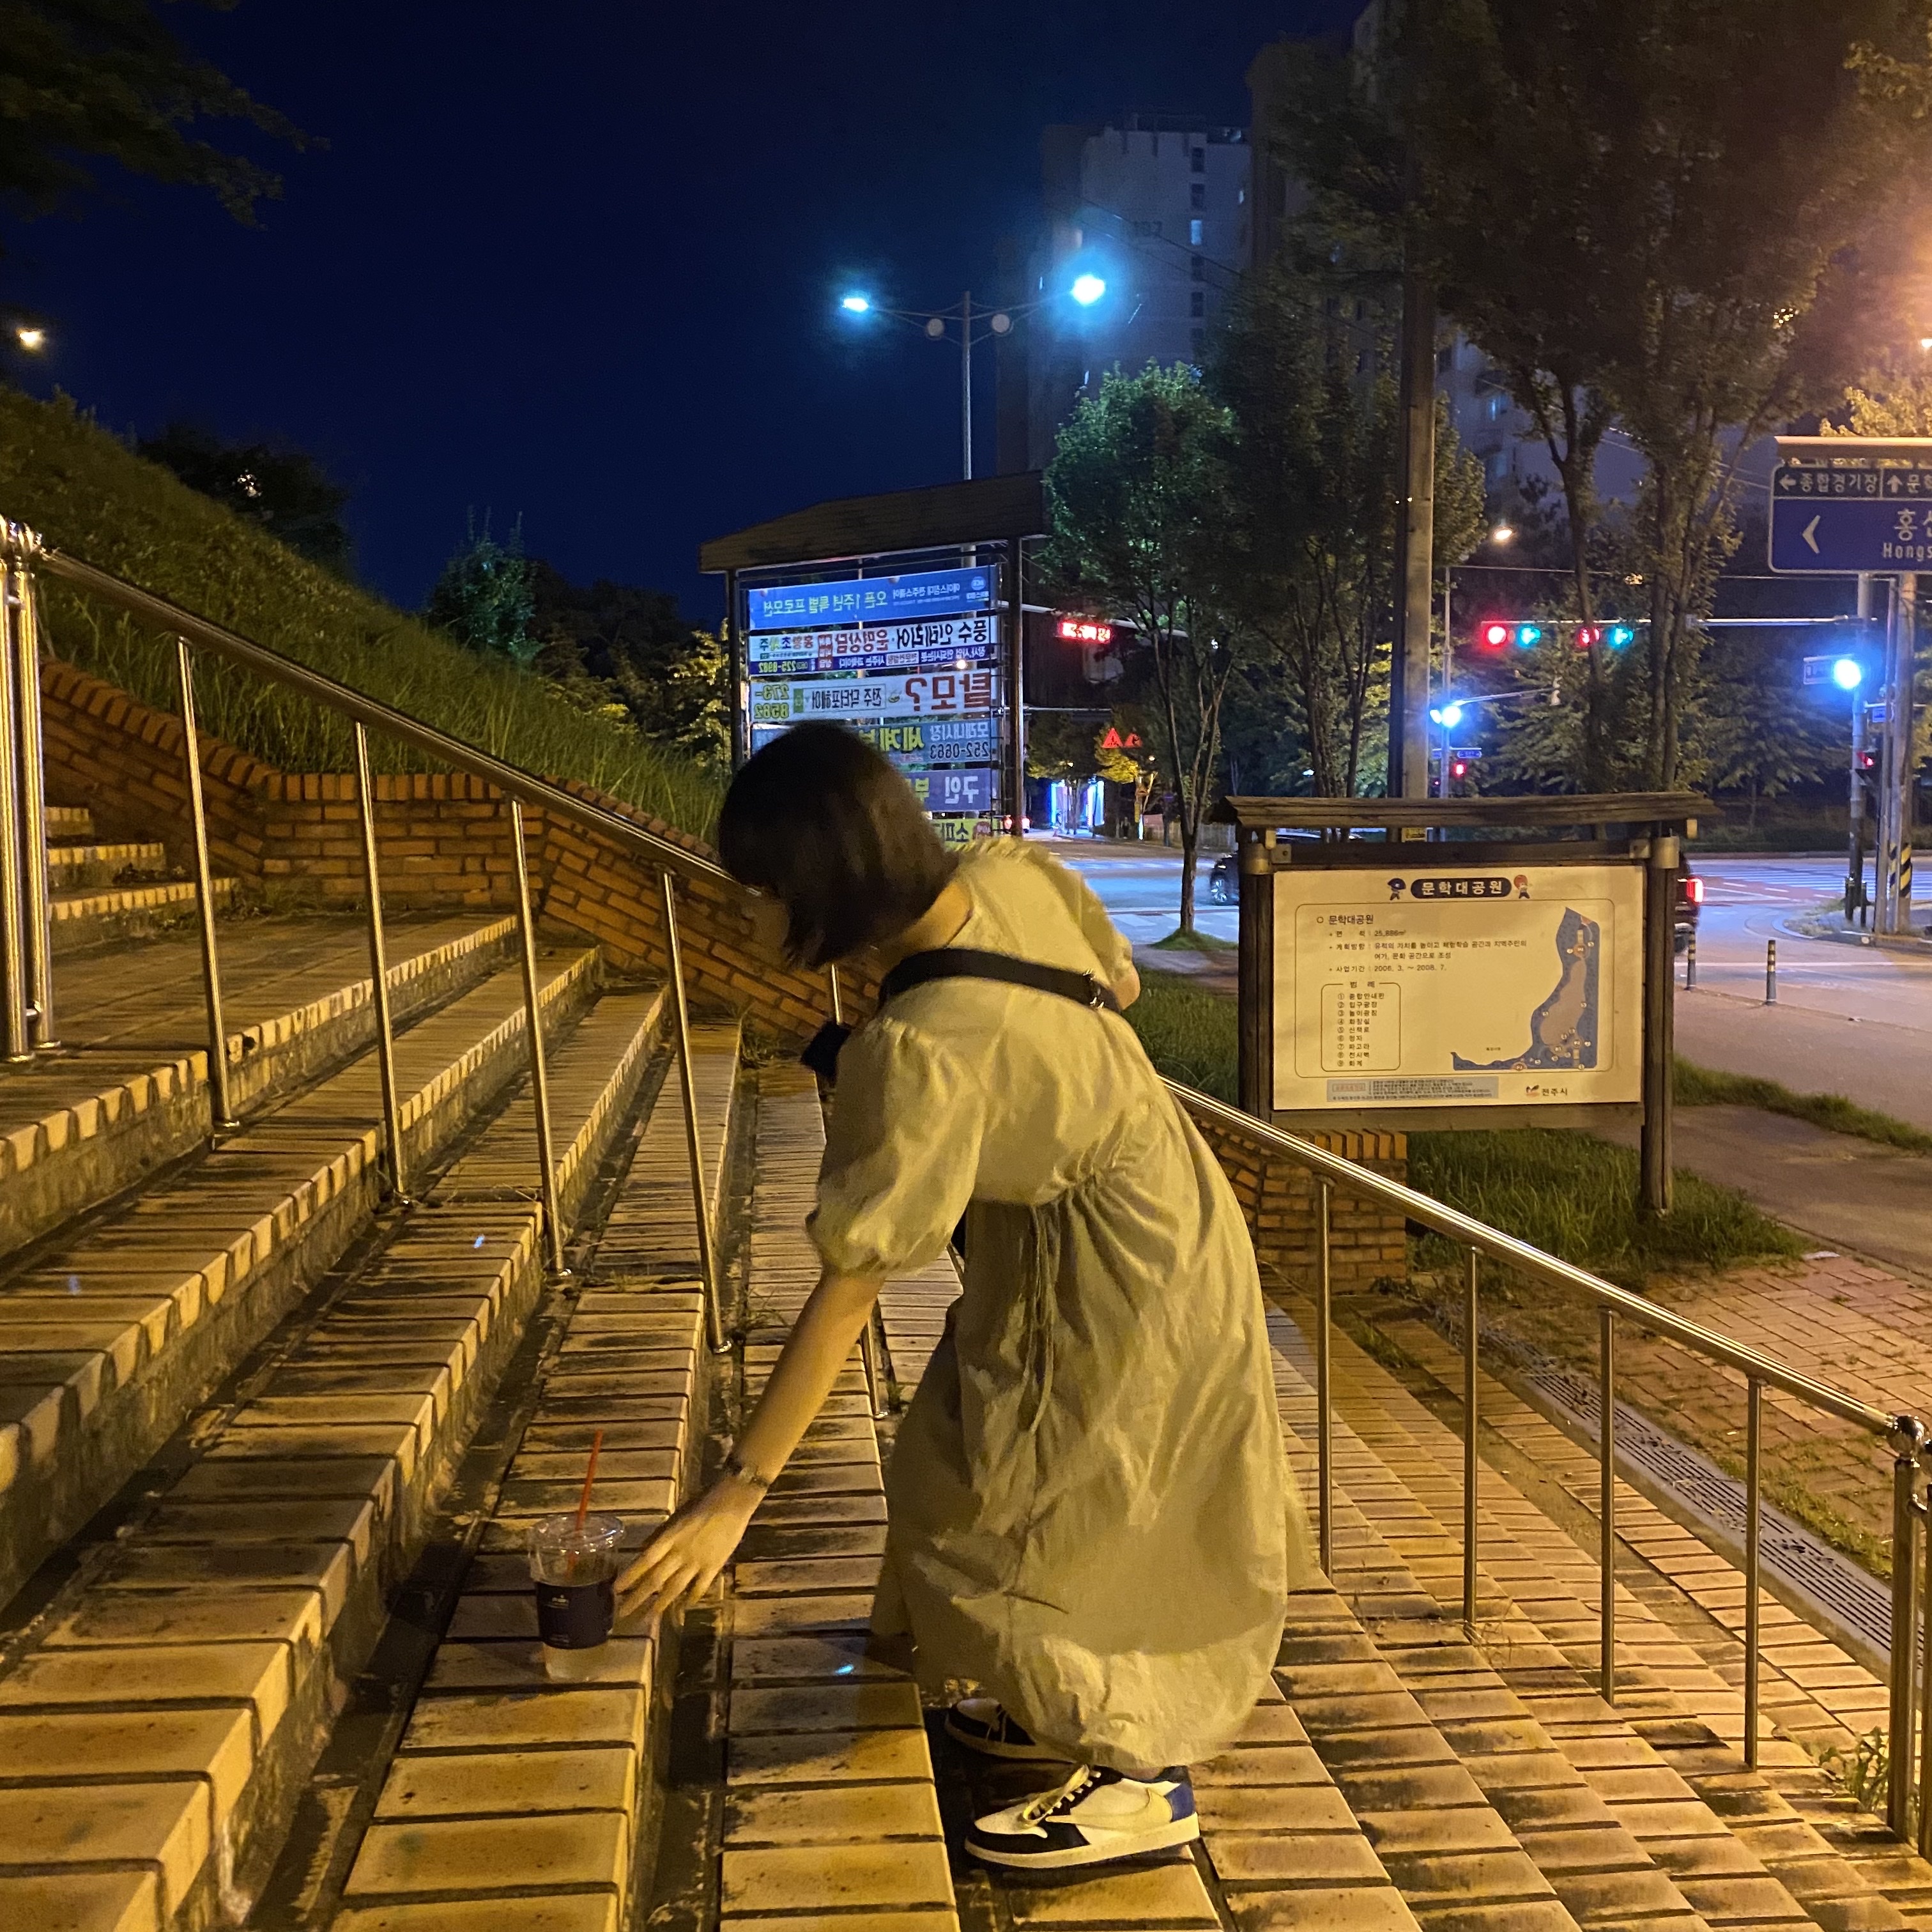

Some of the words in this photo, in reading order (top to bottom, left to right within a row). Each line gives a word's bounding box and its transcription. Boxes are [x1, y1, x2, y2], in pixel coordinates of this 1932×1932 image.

[1800, 473, 1877, 493] 종합경기장
[1422, 880, 1502, 896] 문학대공원
[1329, 914, 1374, 925] 문학대공원
[1542, 1088, 1567, 1096] 전주시
